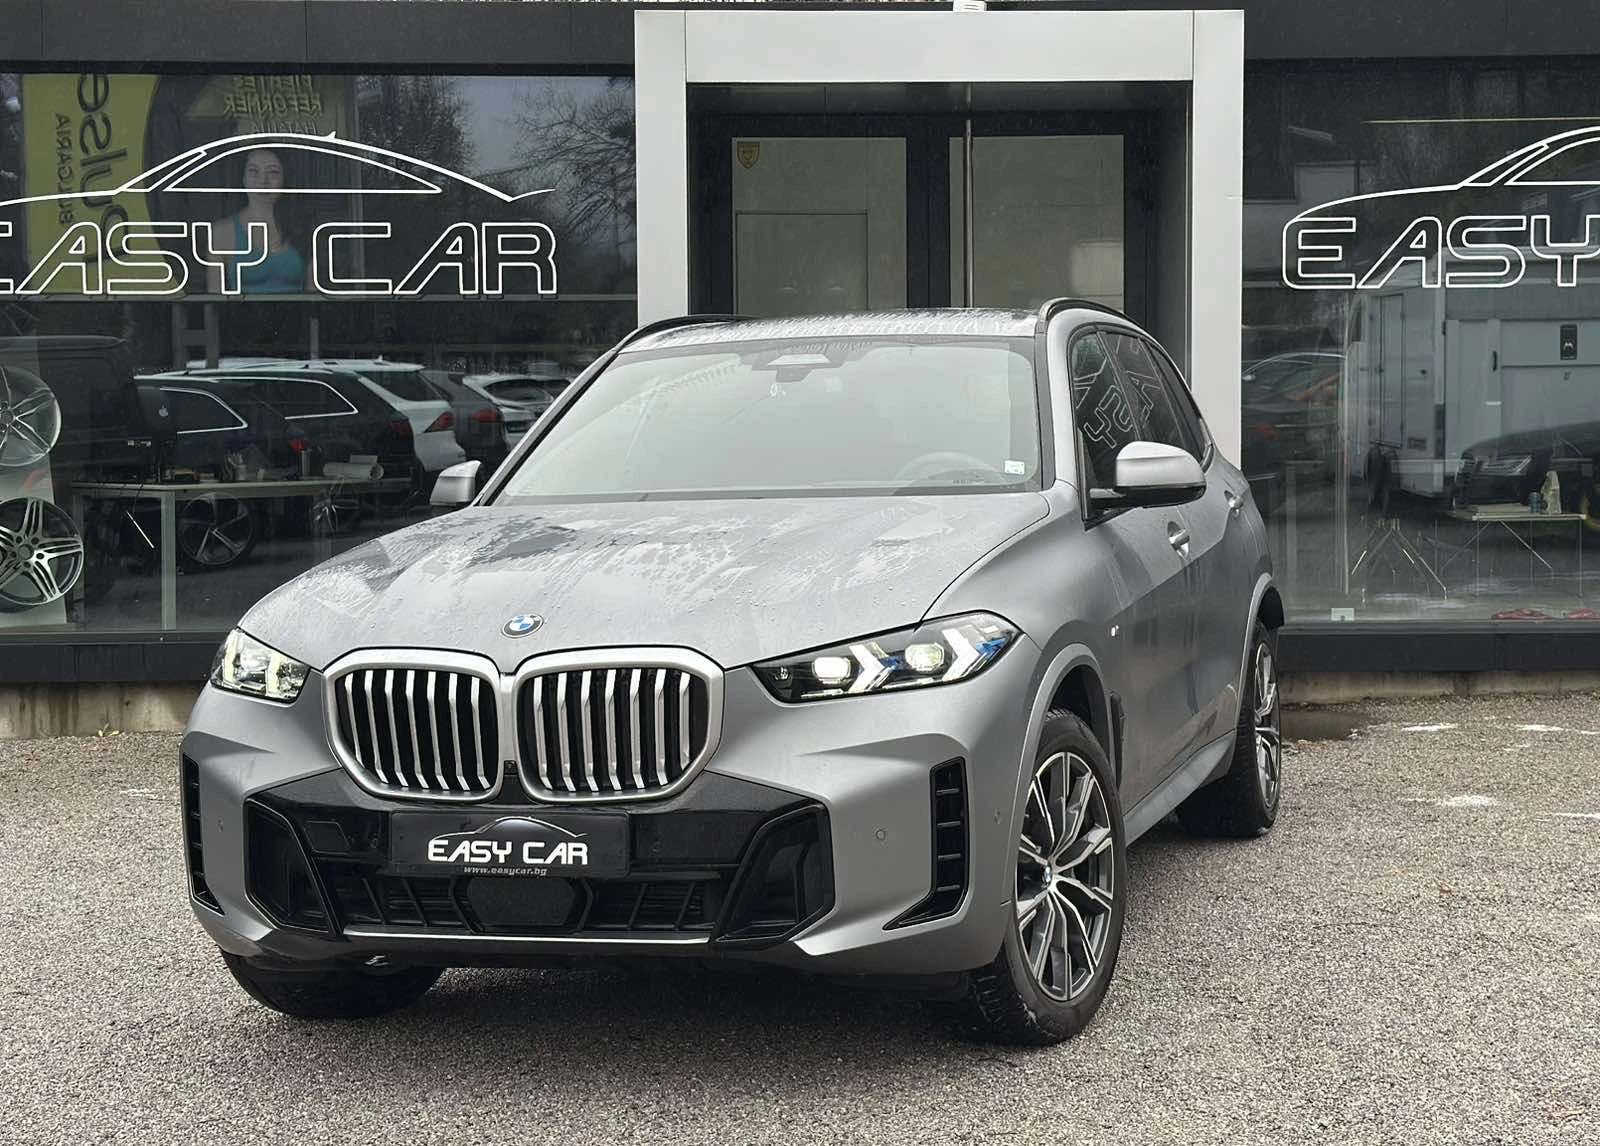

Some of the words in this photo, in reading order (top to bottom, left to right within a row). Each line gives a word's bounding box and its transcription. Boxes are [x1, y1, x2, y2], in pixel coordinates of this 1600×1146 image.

[0, 222, 269, 295] ASY
[312, 222, 557, 295] CAR
[1282, 214, 1600, 289] EASY
[427, 839, 512, 863] EASY
[522, 841, 588, 865] CAR
[463, 866, 548, 877] www.easycar.bg
